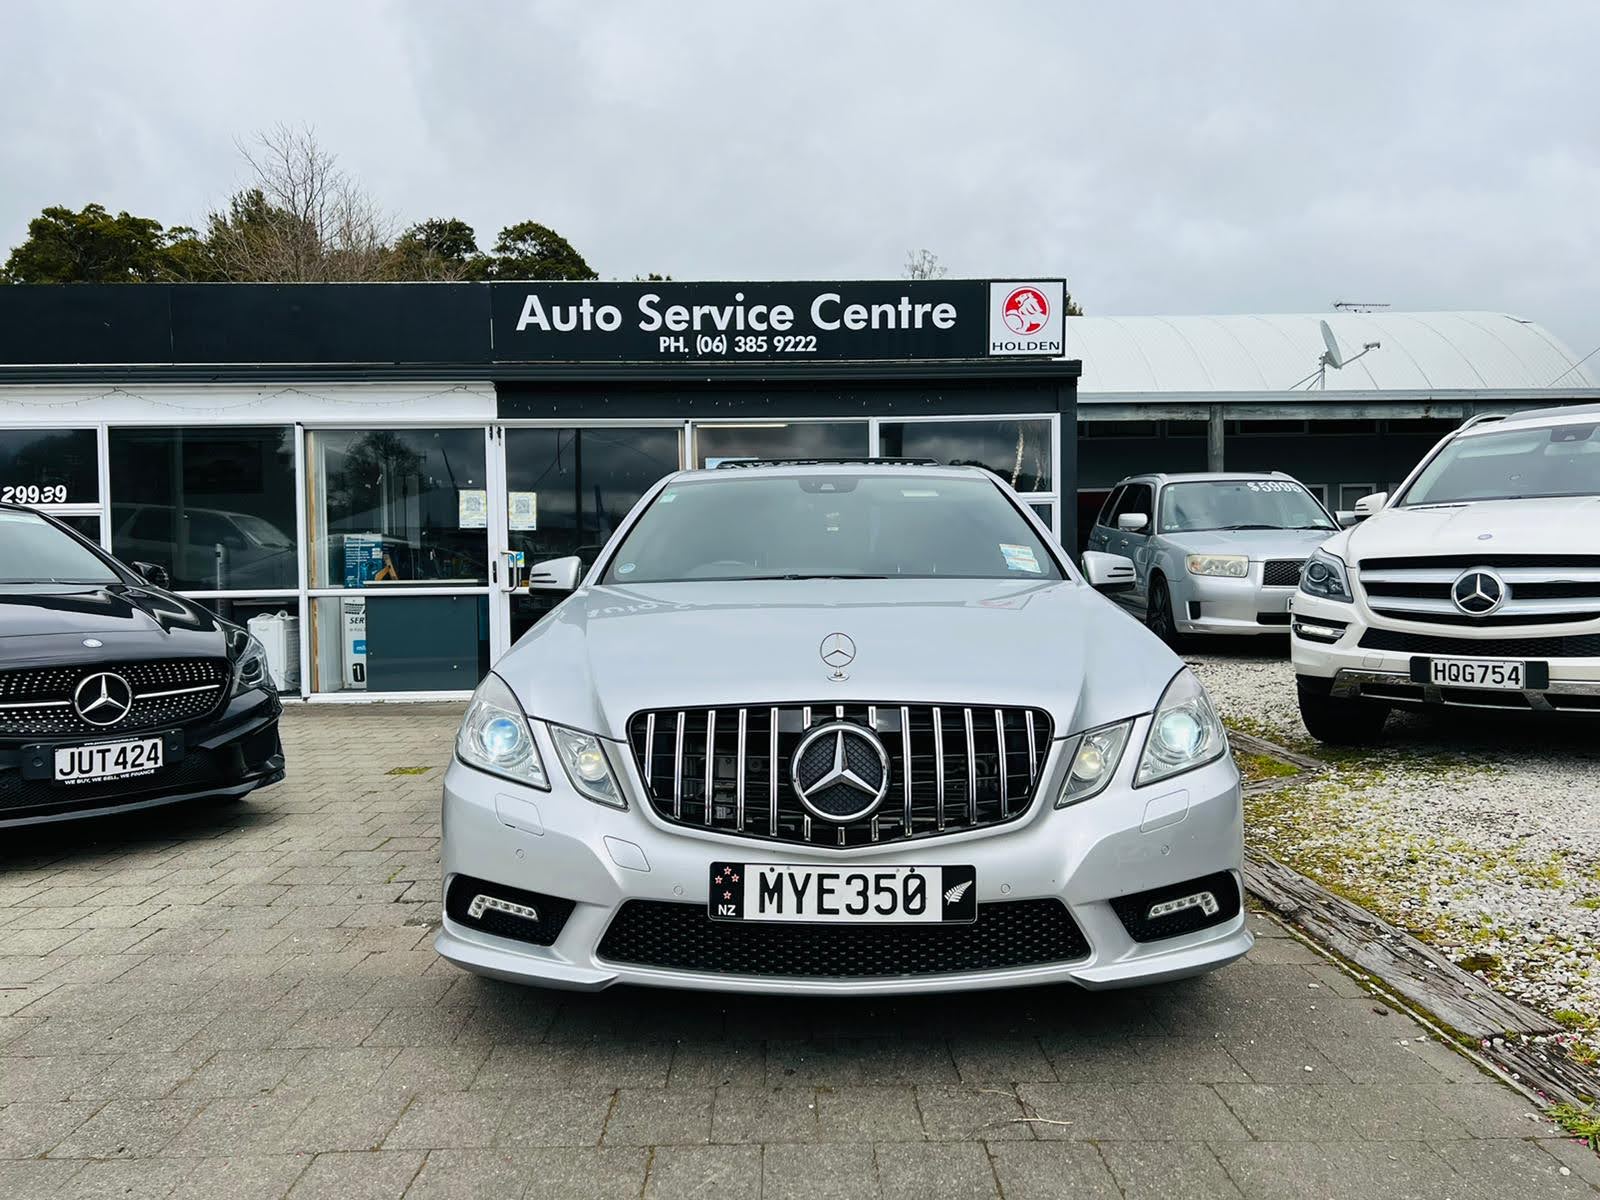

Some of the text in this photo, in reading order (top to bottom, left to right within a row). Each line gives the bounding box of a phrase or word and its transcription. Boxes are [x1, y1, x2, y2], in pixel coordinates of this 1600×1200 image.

[515, 292, 957, 332] Auto Service Centre
[659, 334, 817, 355] PH. (06) 385 9222
[992, 341, 1060, 351] HOLDEN
[1434, 662, 1521, 685] HQG754
[58, 742, 160, 776] JUT424
[130, 768, 155, 777] FINANCE
[758, 871, 927, 916] MYE350
[717, 903, 736, 916] NZ
